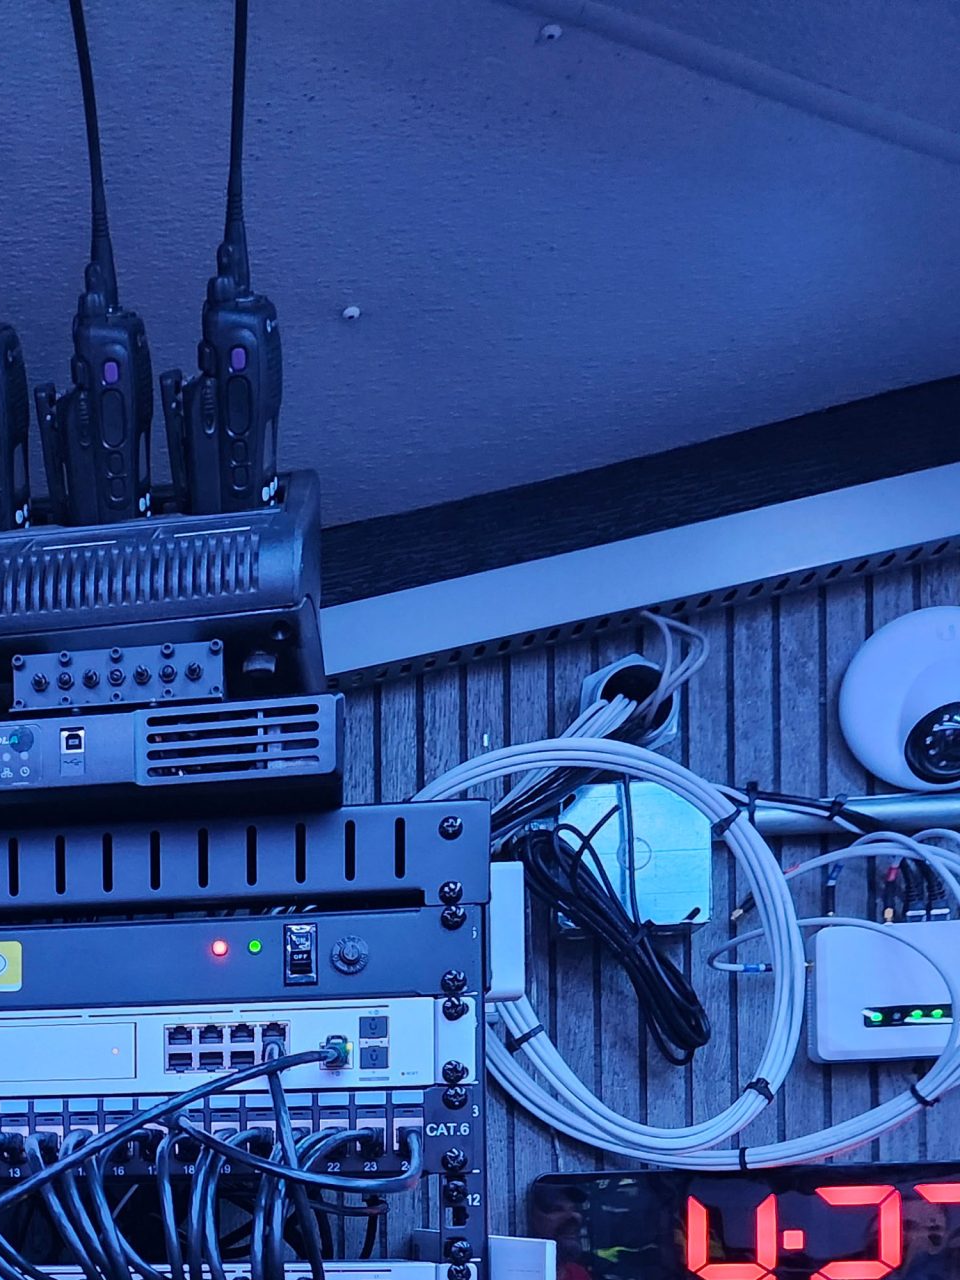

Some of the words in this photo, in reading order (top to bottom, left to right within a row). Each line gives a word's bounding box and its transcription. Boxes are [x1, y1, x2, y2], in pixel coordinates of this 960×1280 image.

[426, 1123, 469, 1136] CAT.6
[113, 1166, 125, 1176] 16
[183, 1165, 195, 1175] 18
[327, 1162, 340, 1172] 22
[364, 1162, 377, 1172] 23
[9, 1168, 21, 1178] 13
[466, 1193, 481, 1206] 12
